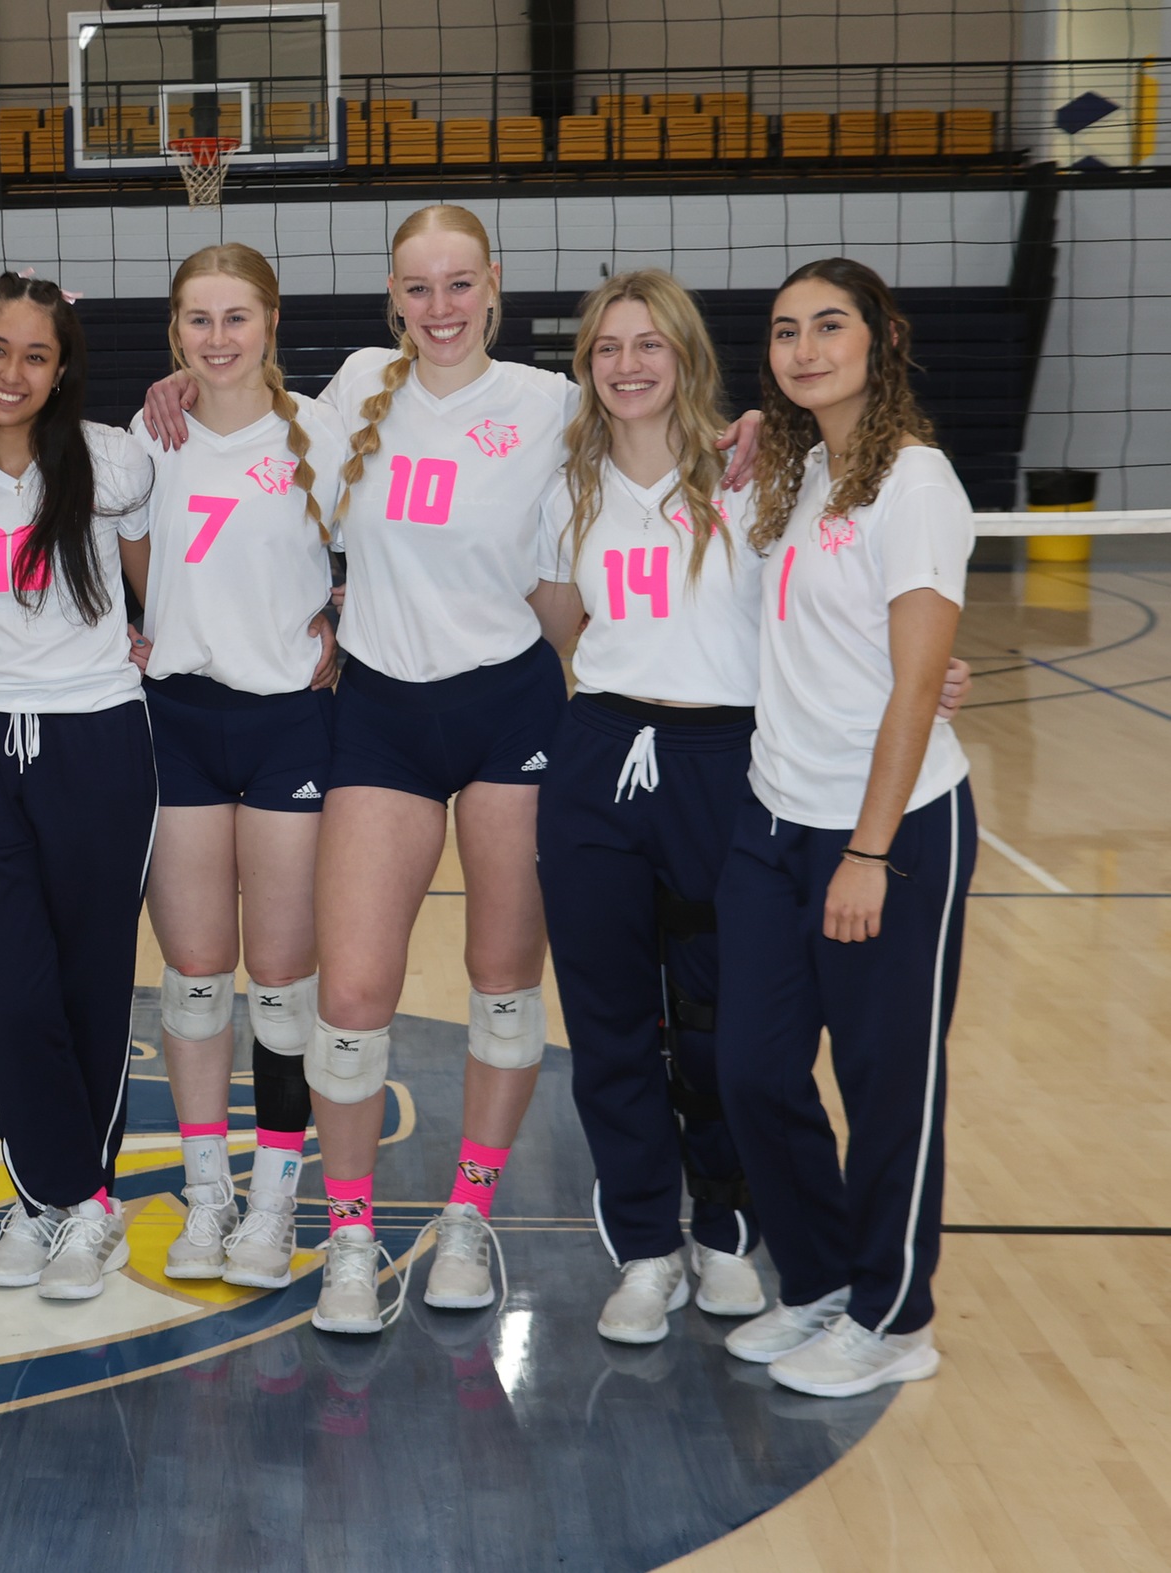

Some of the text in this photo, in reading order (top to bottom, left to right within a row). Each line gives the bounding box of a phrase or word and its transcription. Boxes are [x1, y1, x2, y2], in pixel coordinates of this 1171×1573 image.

[385, 454, 459, 526] 10
[184, 494, 240, 564] 7
[603, 545, 670, 621] 14
[777, 545, 797, 621] 1
